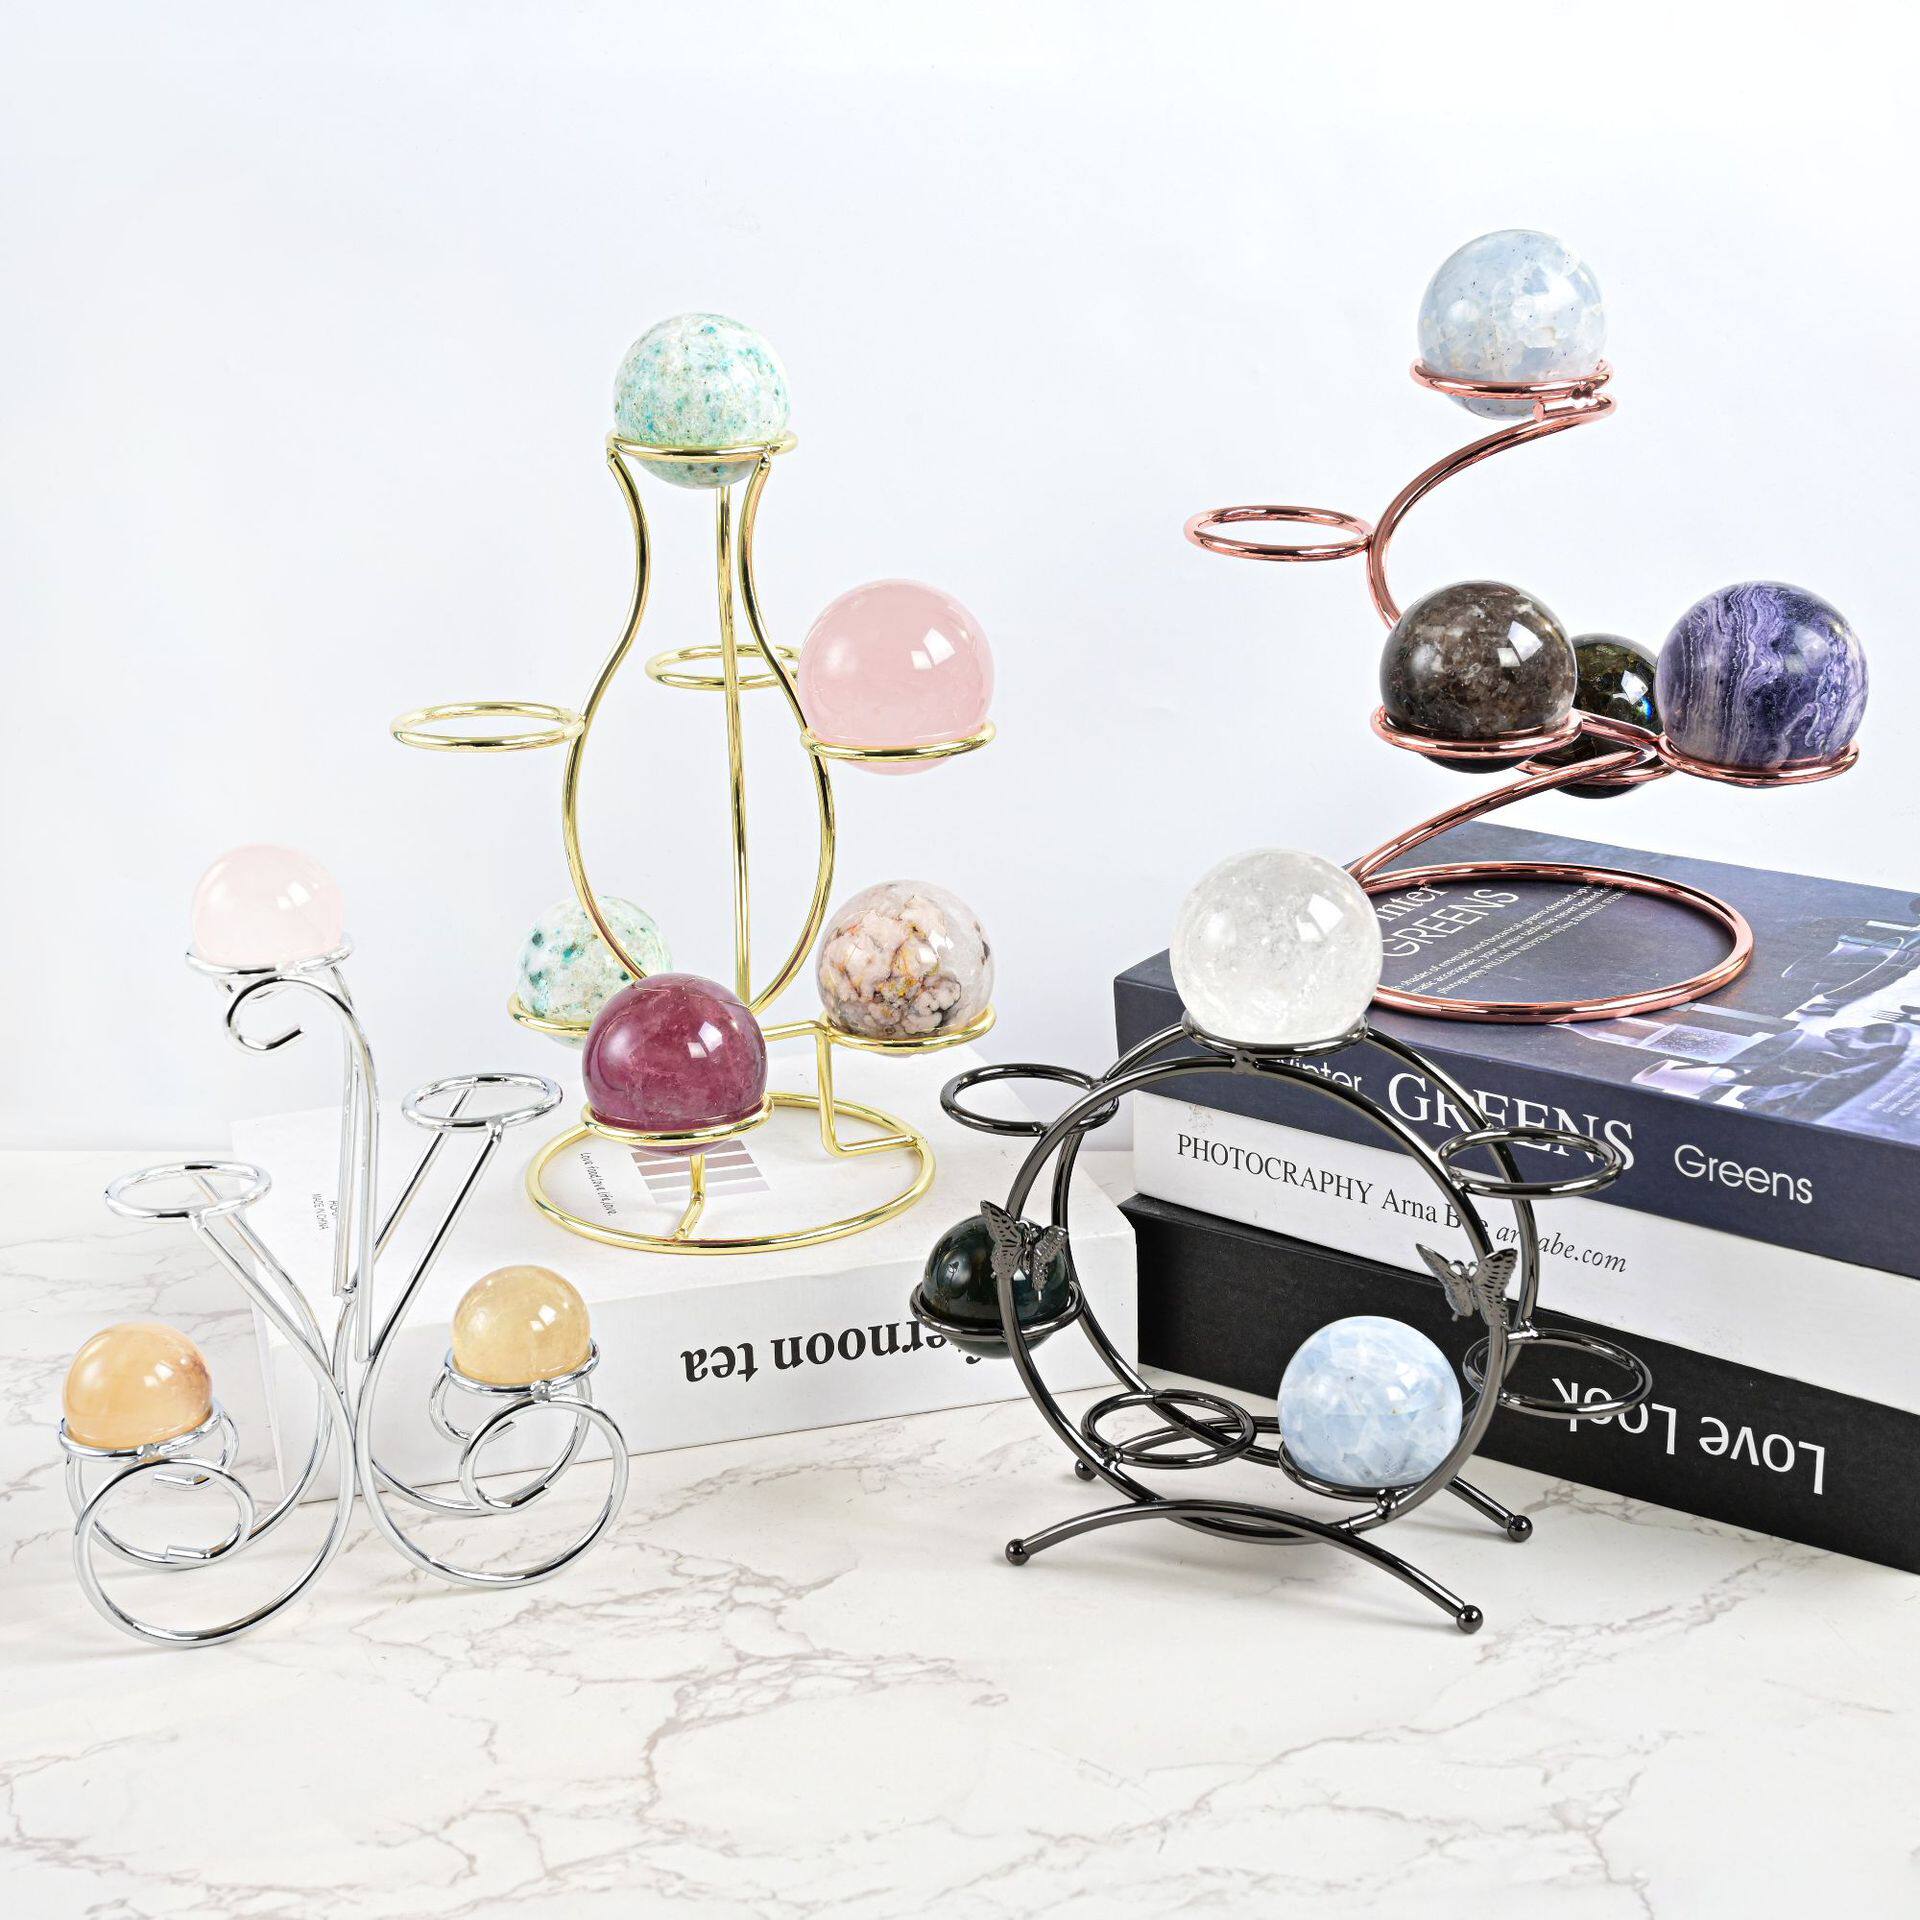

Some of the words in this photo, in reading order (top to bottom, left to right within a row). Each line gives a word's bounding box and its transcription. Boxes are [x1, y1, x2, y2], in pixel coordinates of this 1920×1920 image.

[1376, 886, 1448, 921] inter
[1382, 889, 1519, 957] GREENS
[1674, 1143, 1814, 1205] Greens
[1381, 1188, 1438, 1224] Arna
[1496, 1226, 1627, 1273] arabe.com
[680, 1342, 758, 1382] tea
[1552, 1378, 1677, 1455] Look
[1699, 1416, 1825, 1495] Love
